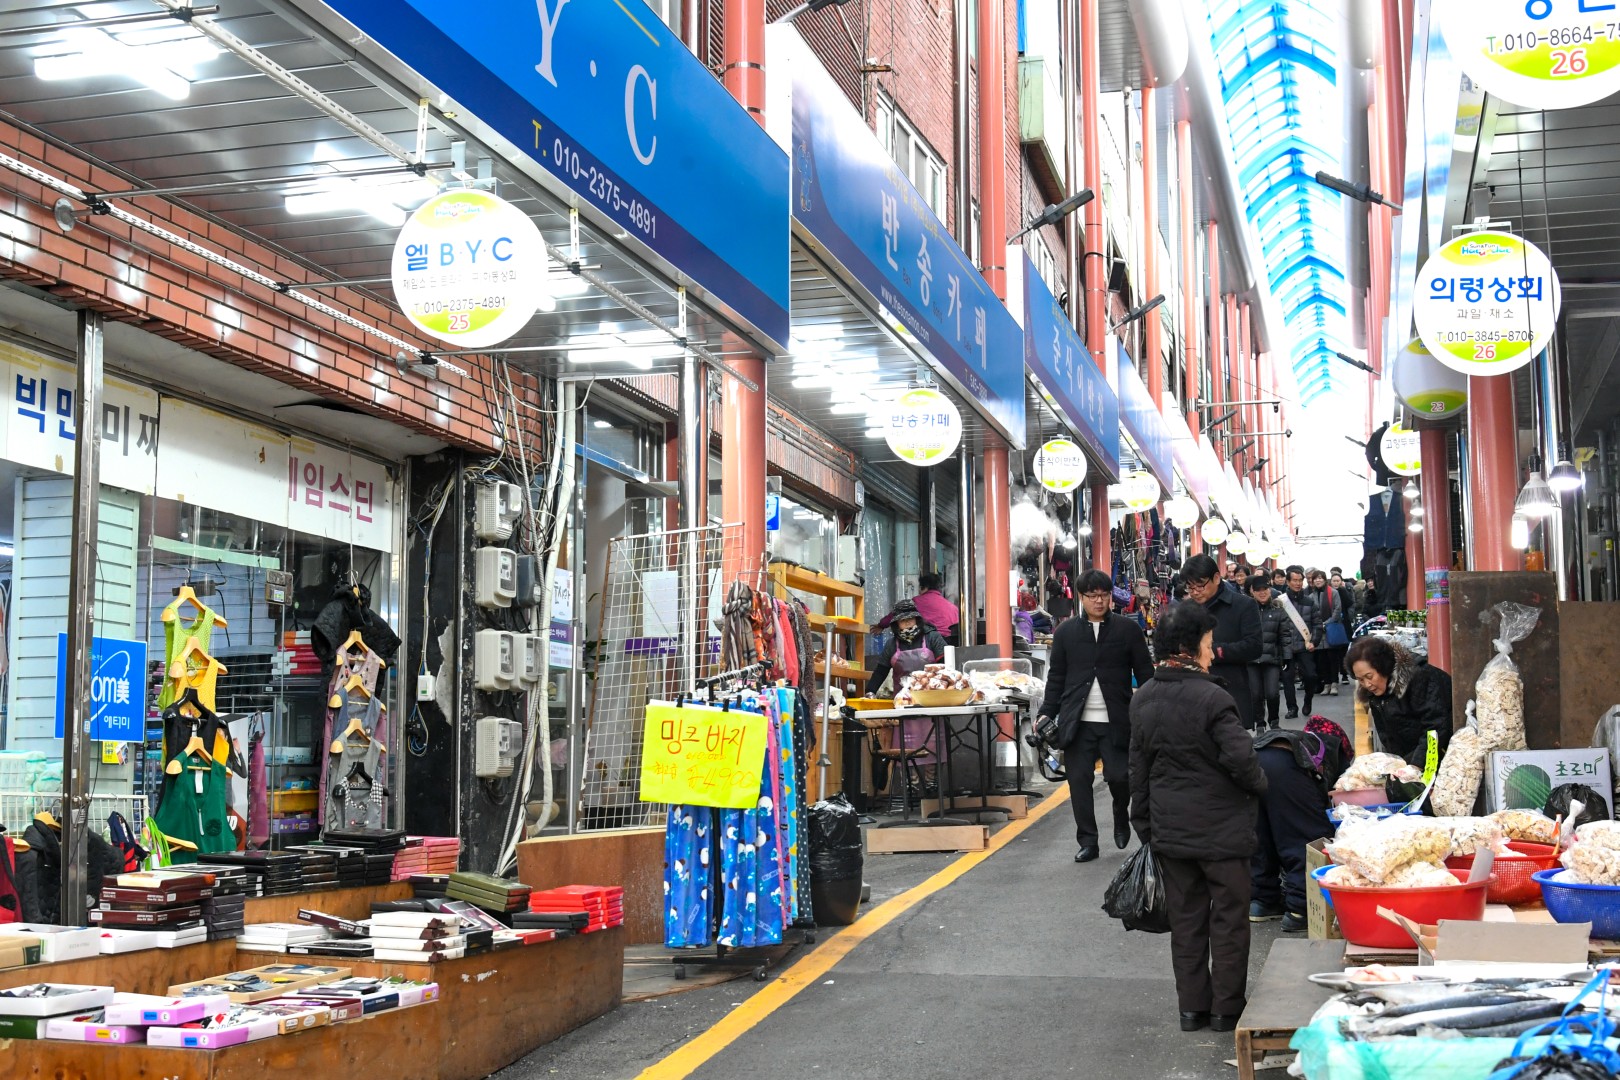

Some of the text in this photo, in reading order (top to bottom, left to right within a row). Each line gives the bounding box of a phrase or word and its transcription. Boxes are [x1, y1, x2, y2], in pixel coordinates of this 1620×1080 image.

[1486, 23, 1620, 52] T.010-8664-7
[1552, 50, 1586, 75] 26
[532, 119, 656, 239] T. 010-2375-4891
[405, 243, 429, 272] 엘
[881, 188, 987, 370] 반송카페
[1430, 276, 1543, 303] 의령상회
[449, 314, 470, 331] 25
[1437, 330, 1535, 343] T.010-3845-8706
[1474, 344, 1496, 360] 26
[1431, 401, 1445, 412] 23
[891, 413, 950, 428] 반송카페
[661, 719, 747, 766] 밍크 바지
